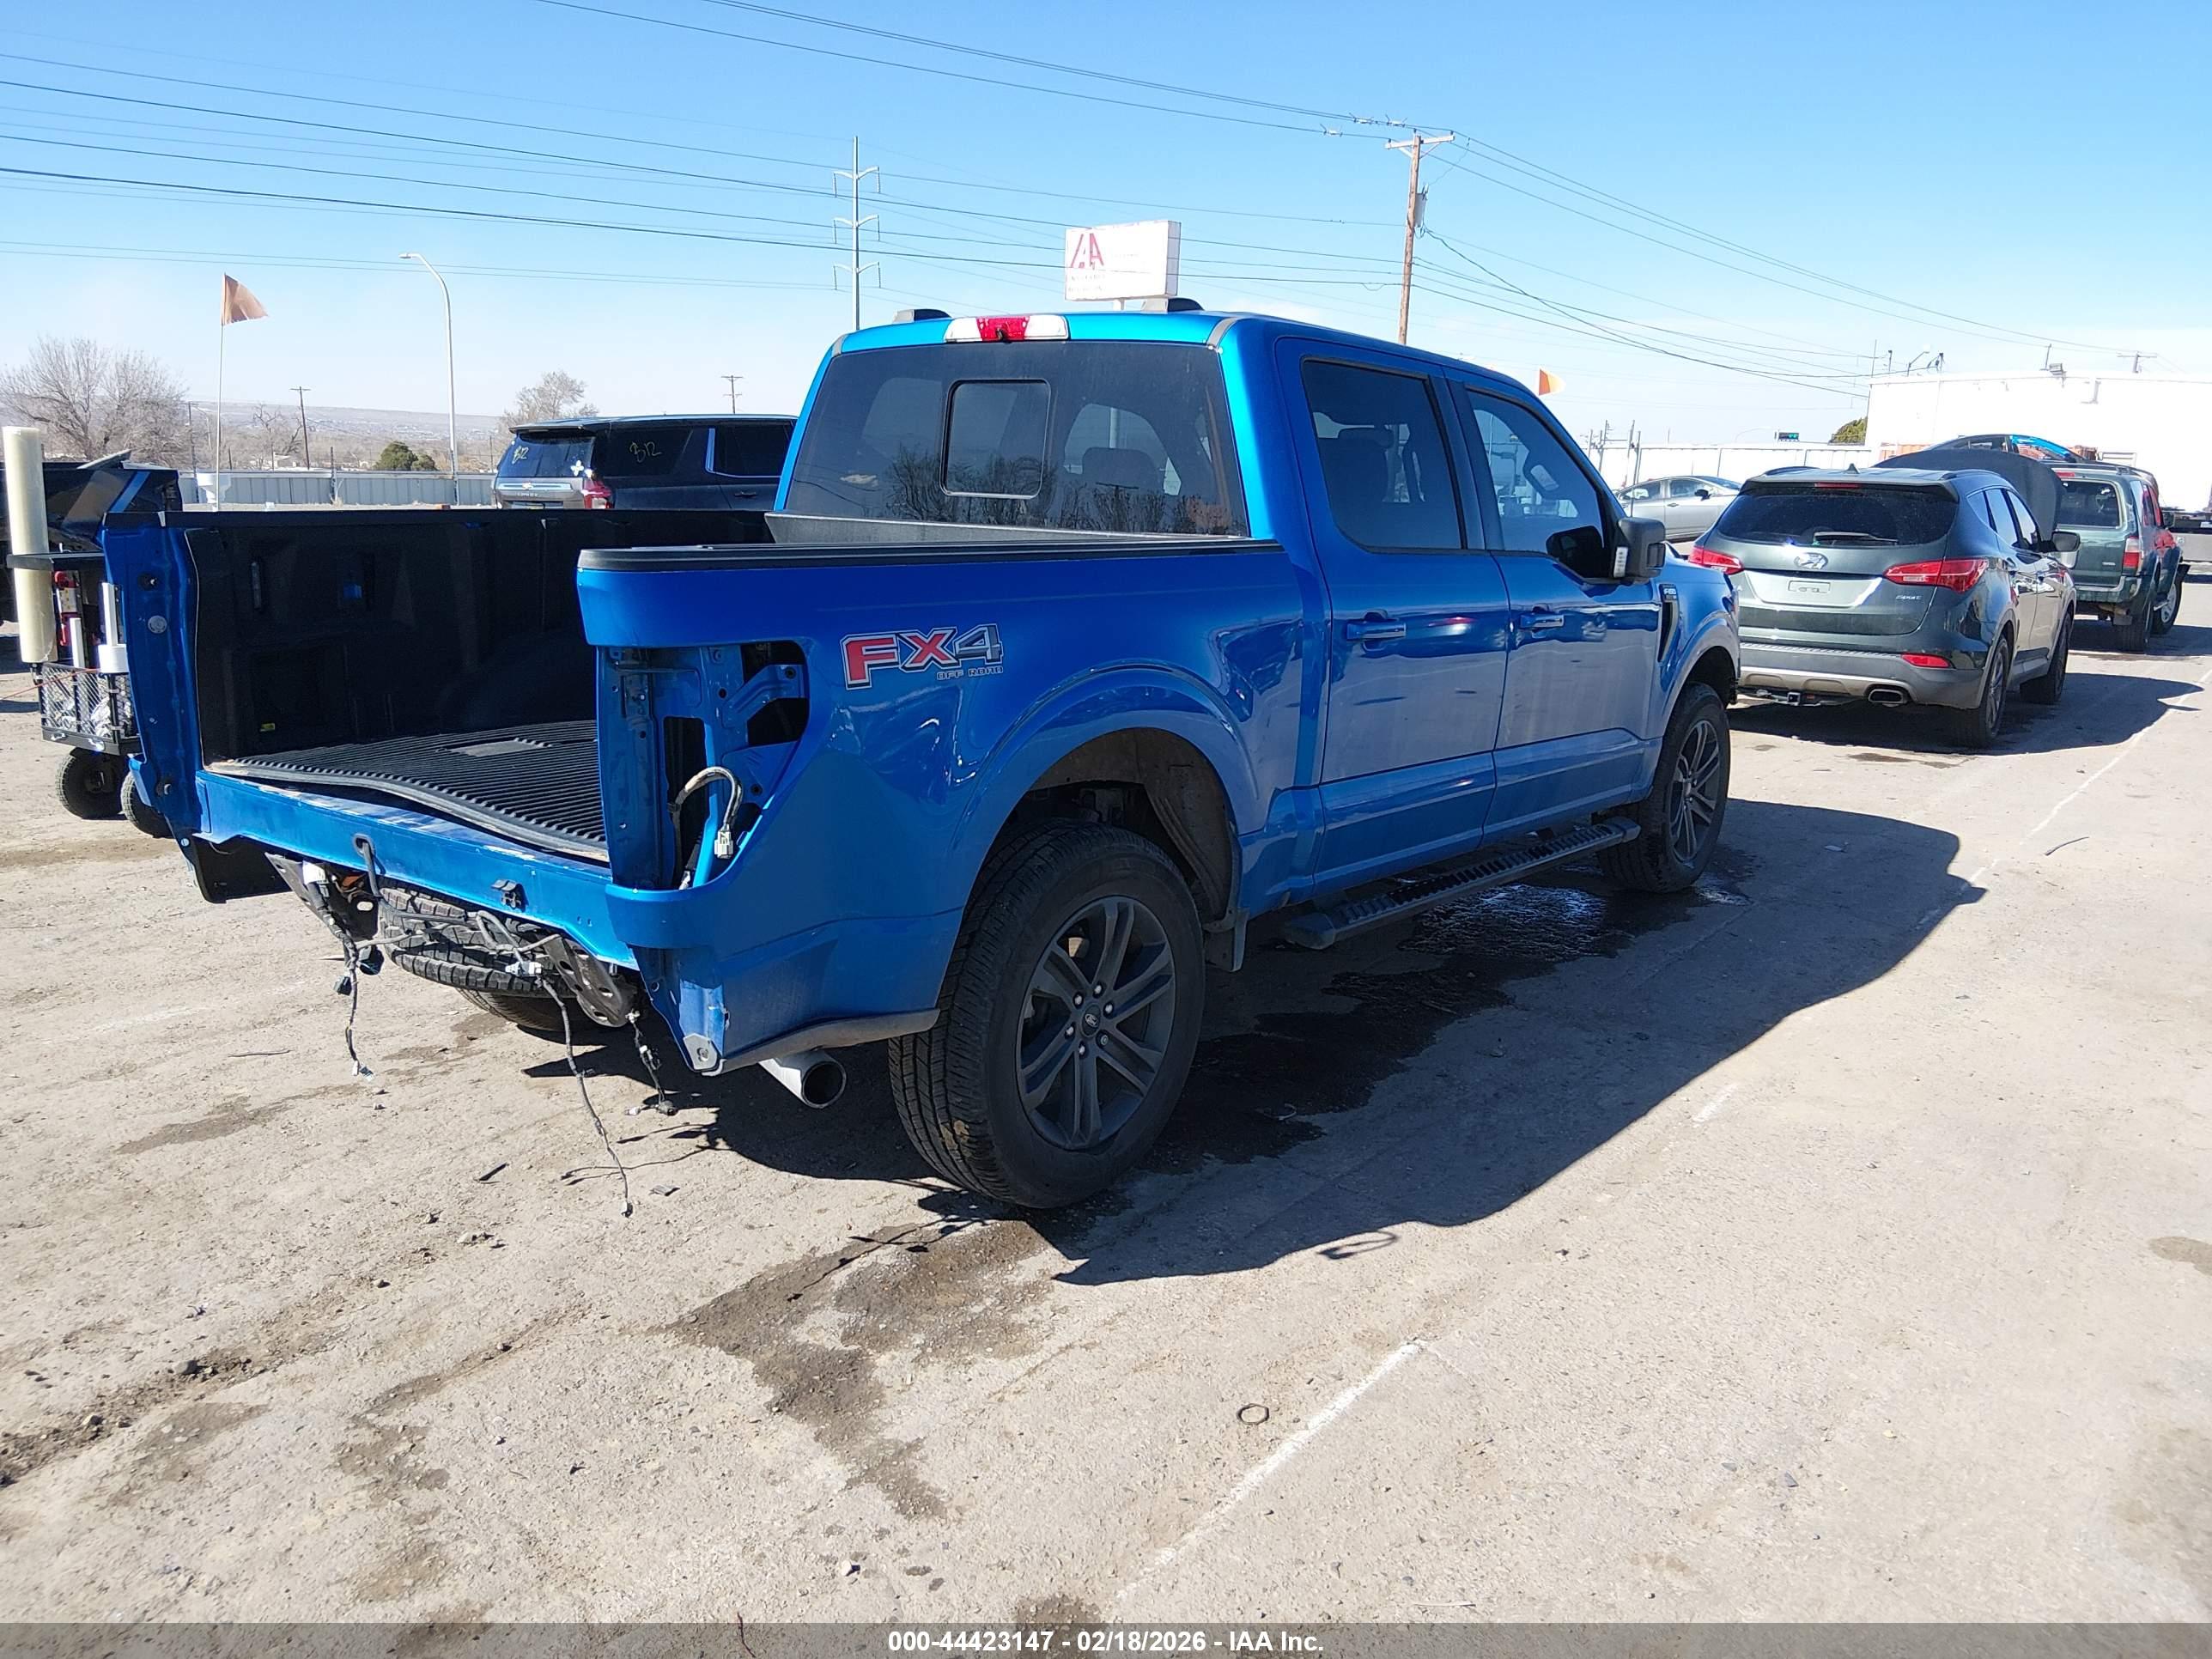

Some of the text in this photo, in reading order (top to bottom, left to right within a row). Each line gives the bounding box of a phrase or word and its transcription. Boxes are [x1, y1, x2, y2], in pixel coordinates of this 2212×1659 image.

[839, 623, 1004, 690] FX4
[936, 666, 1004, 681] OFF ROAD
